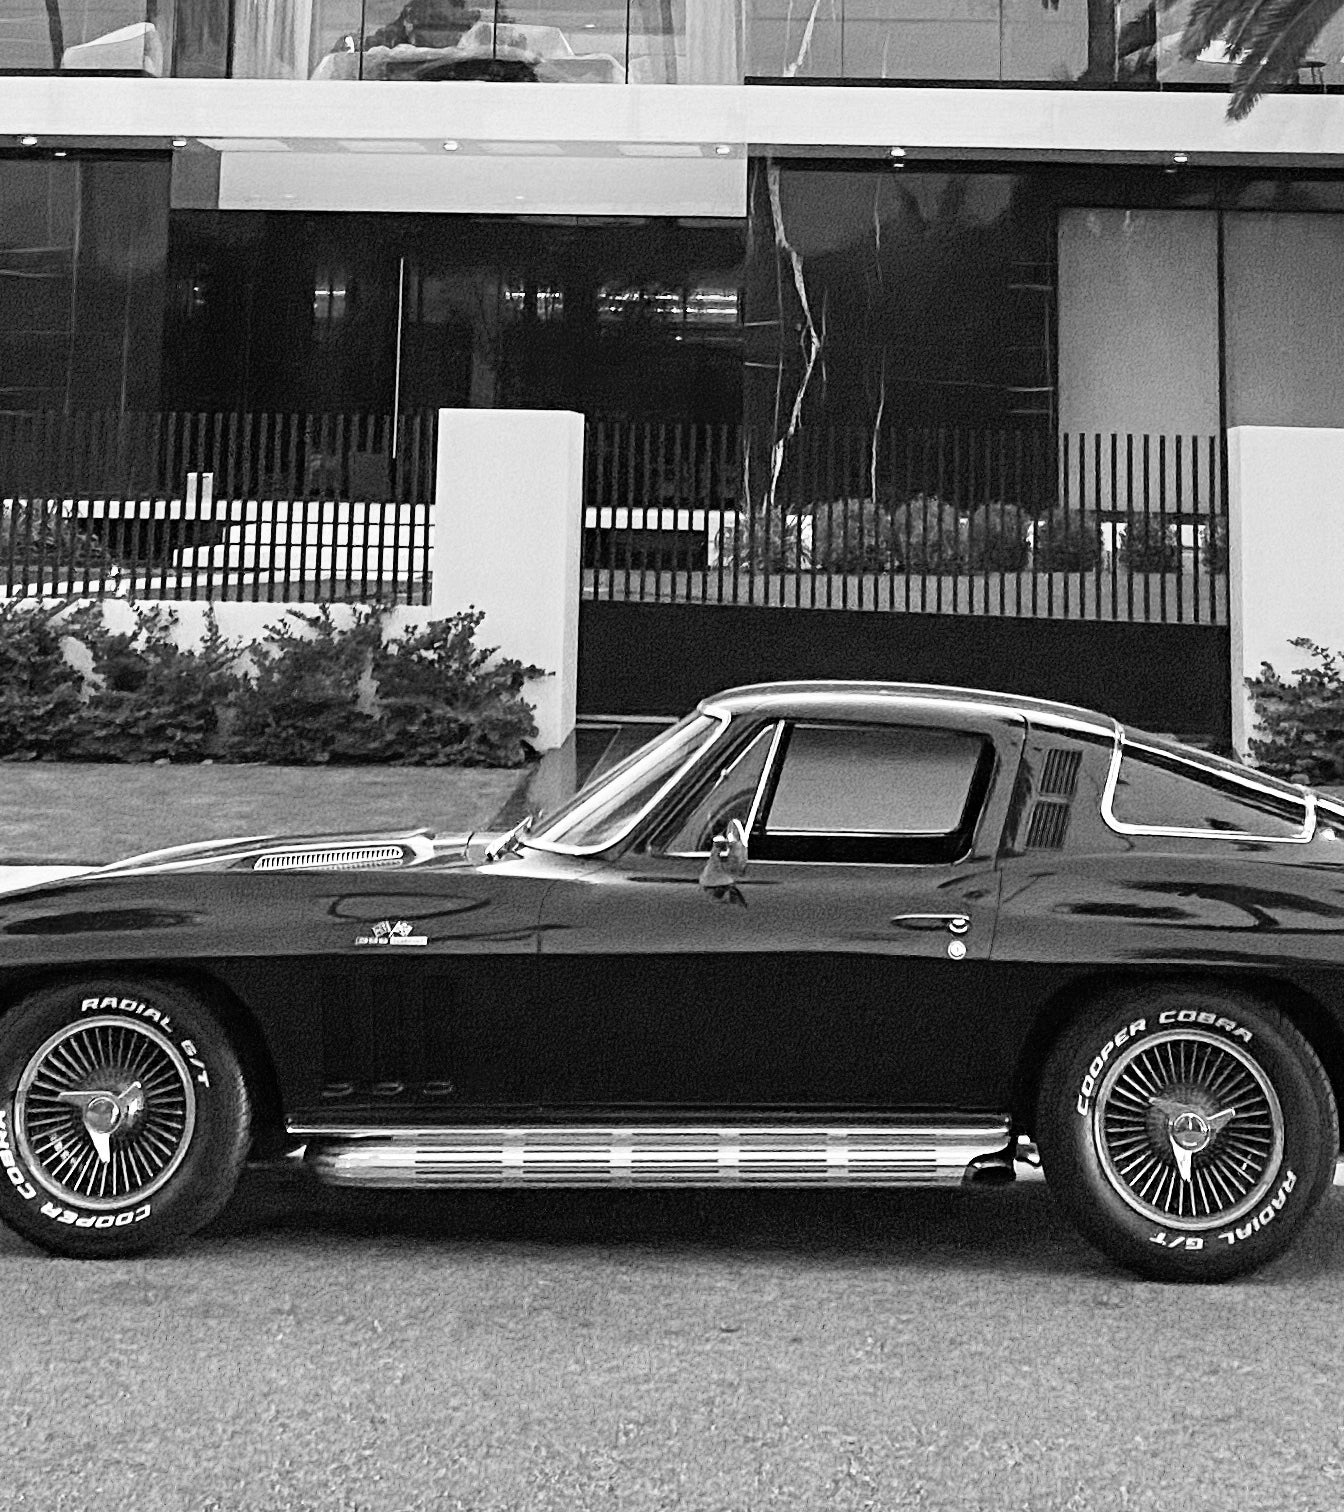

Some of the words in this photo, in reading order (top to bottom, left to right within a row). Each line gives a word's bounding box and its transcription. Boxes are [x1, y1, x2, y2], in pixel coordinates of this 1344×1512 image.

[81, 996, 173, 1033] RADIAL
[181, 1040, 210, 1088] G/T
[1076, 1018, 1147, 1116] COOPER
[1159, 1010, 1253, 1043] COBRA
[40, 1201, 151, 1228] COOPER
[1149, 1232, 1204, 1250] G/T
[1218, 1170, 1297, 1244] RADIAL
